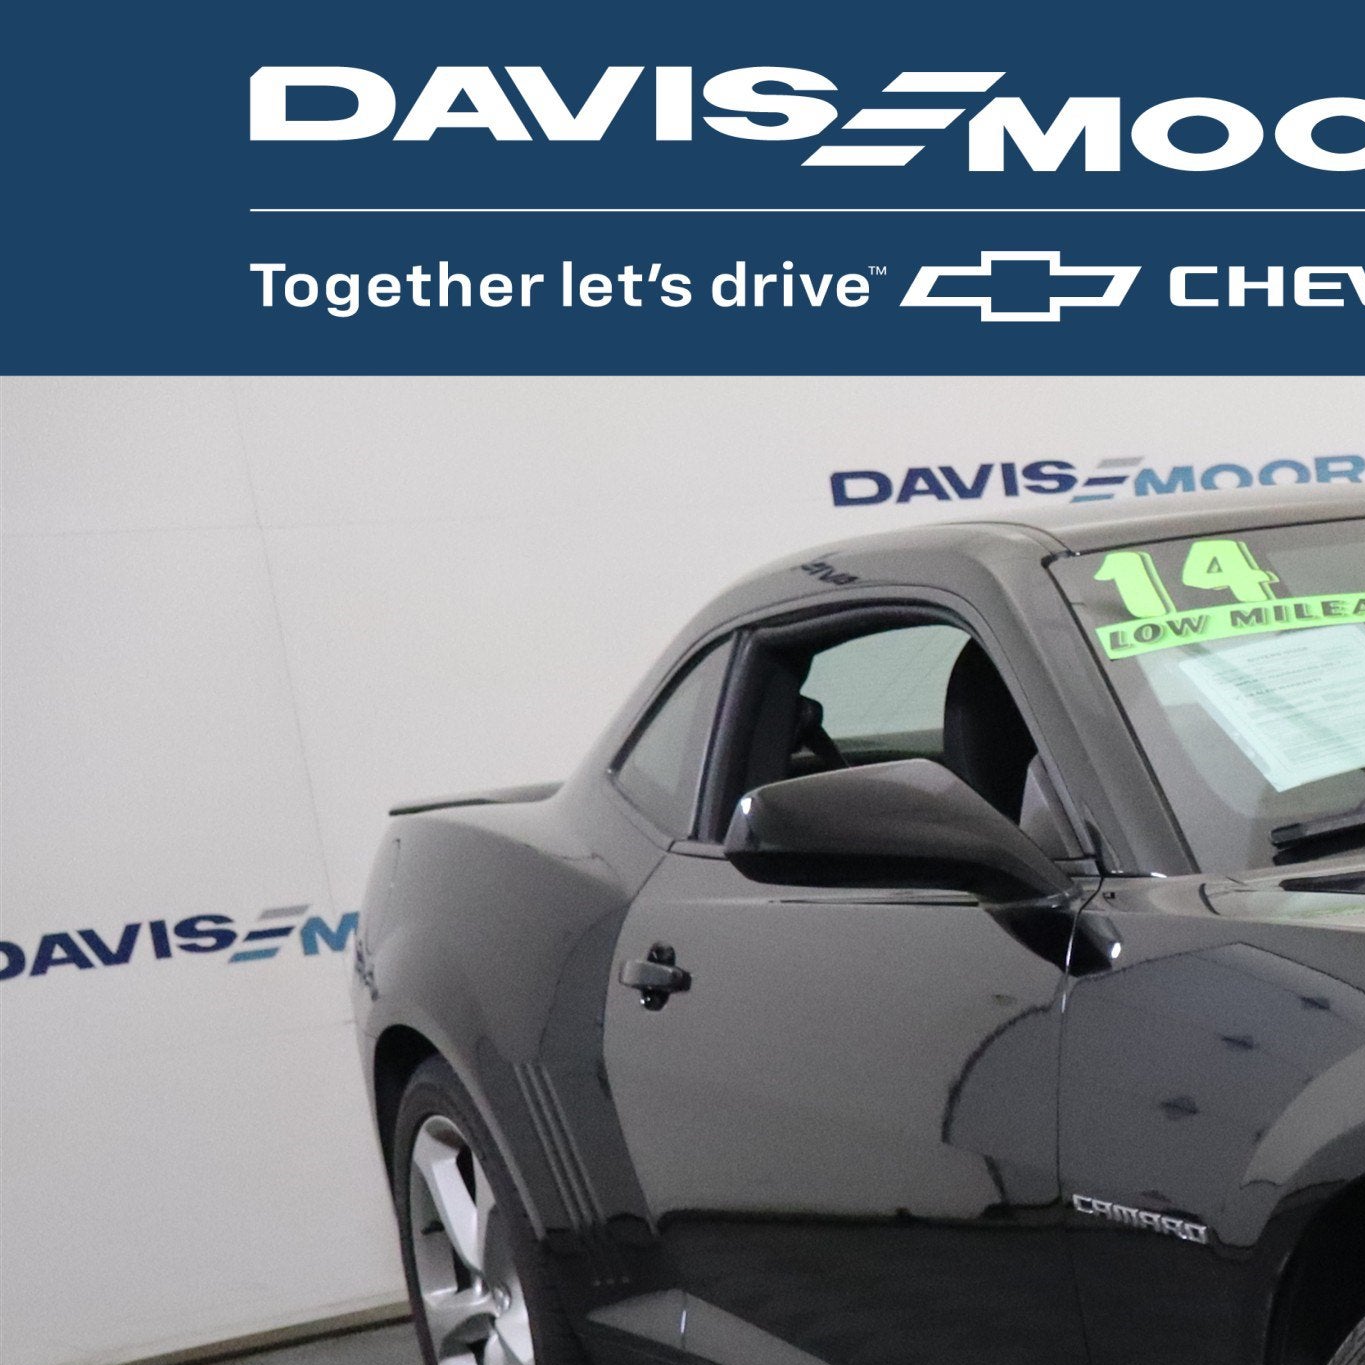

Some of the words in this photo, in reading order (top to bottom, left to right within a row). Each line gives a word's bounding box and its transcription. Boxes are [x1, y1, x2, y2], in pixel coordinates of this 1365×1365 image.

[830, 459, 1078, 507] DAVIS
[1094, 539, 1280, 618] 14
[1108, 614, 1210, 651] LOW
[1072, 1194, 1207, 1244] CAMARO
